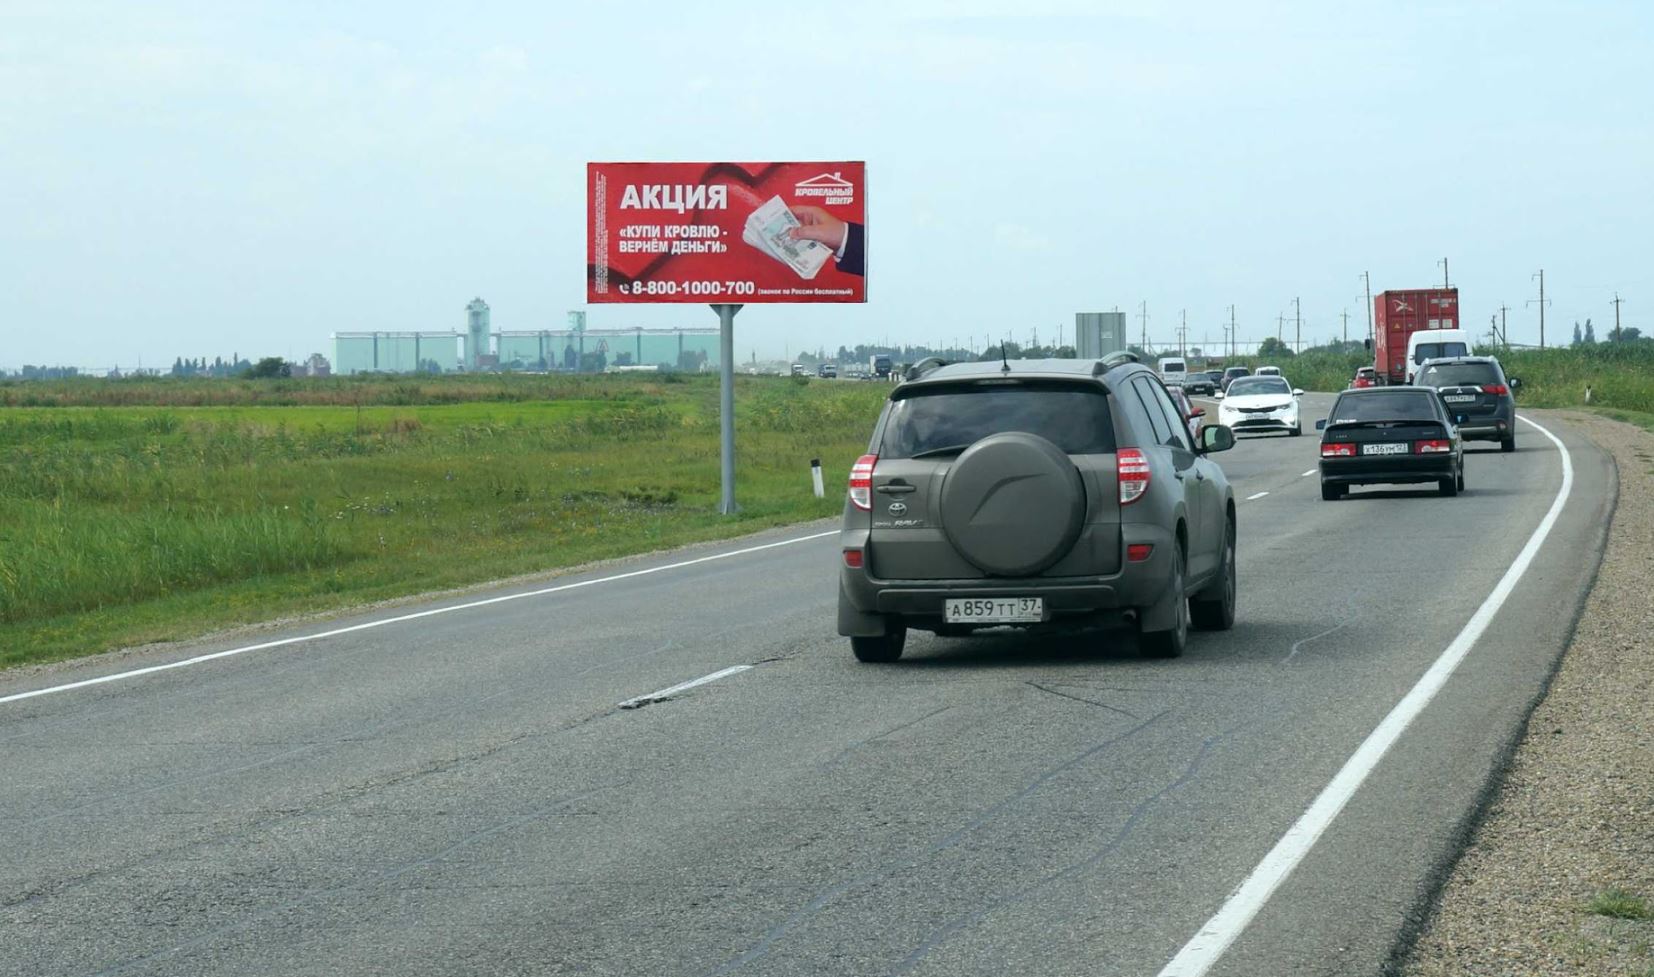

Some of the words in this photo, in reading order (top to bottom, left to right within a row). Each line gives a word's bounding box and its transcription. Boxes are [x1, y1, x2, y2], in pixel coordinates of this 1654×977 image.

[619, 184, 728, 214] АКЦИЯ
[825, 196, 854, 205] ЦЕНТР
[619, 225, 661, 238] «КУПИ
[664, 225, 720, 238] КРОВЛЮ
[619, 238, 669, 253] ВЕРНЁМ
[671, 240, 728, 255] ДЕНЬГИ»
[632, 280, 755, 295] 8-800-1000-700
[1020, 599, 1037, 611] 37
